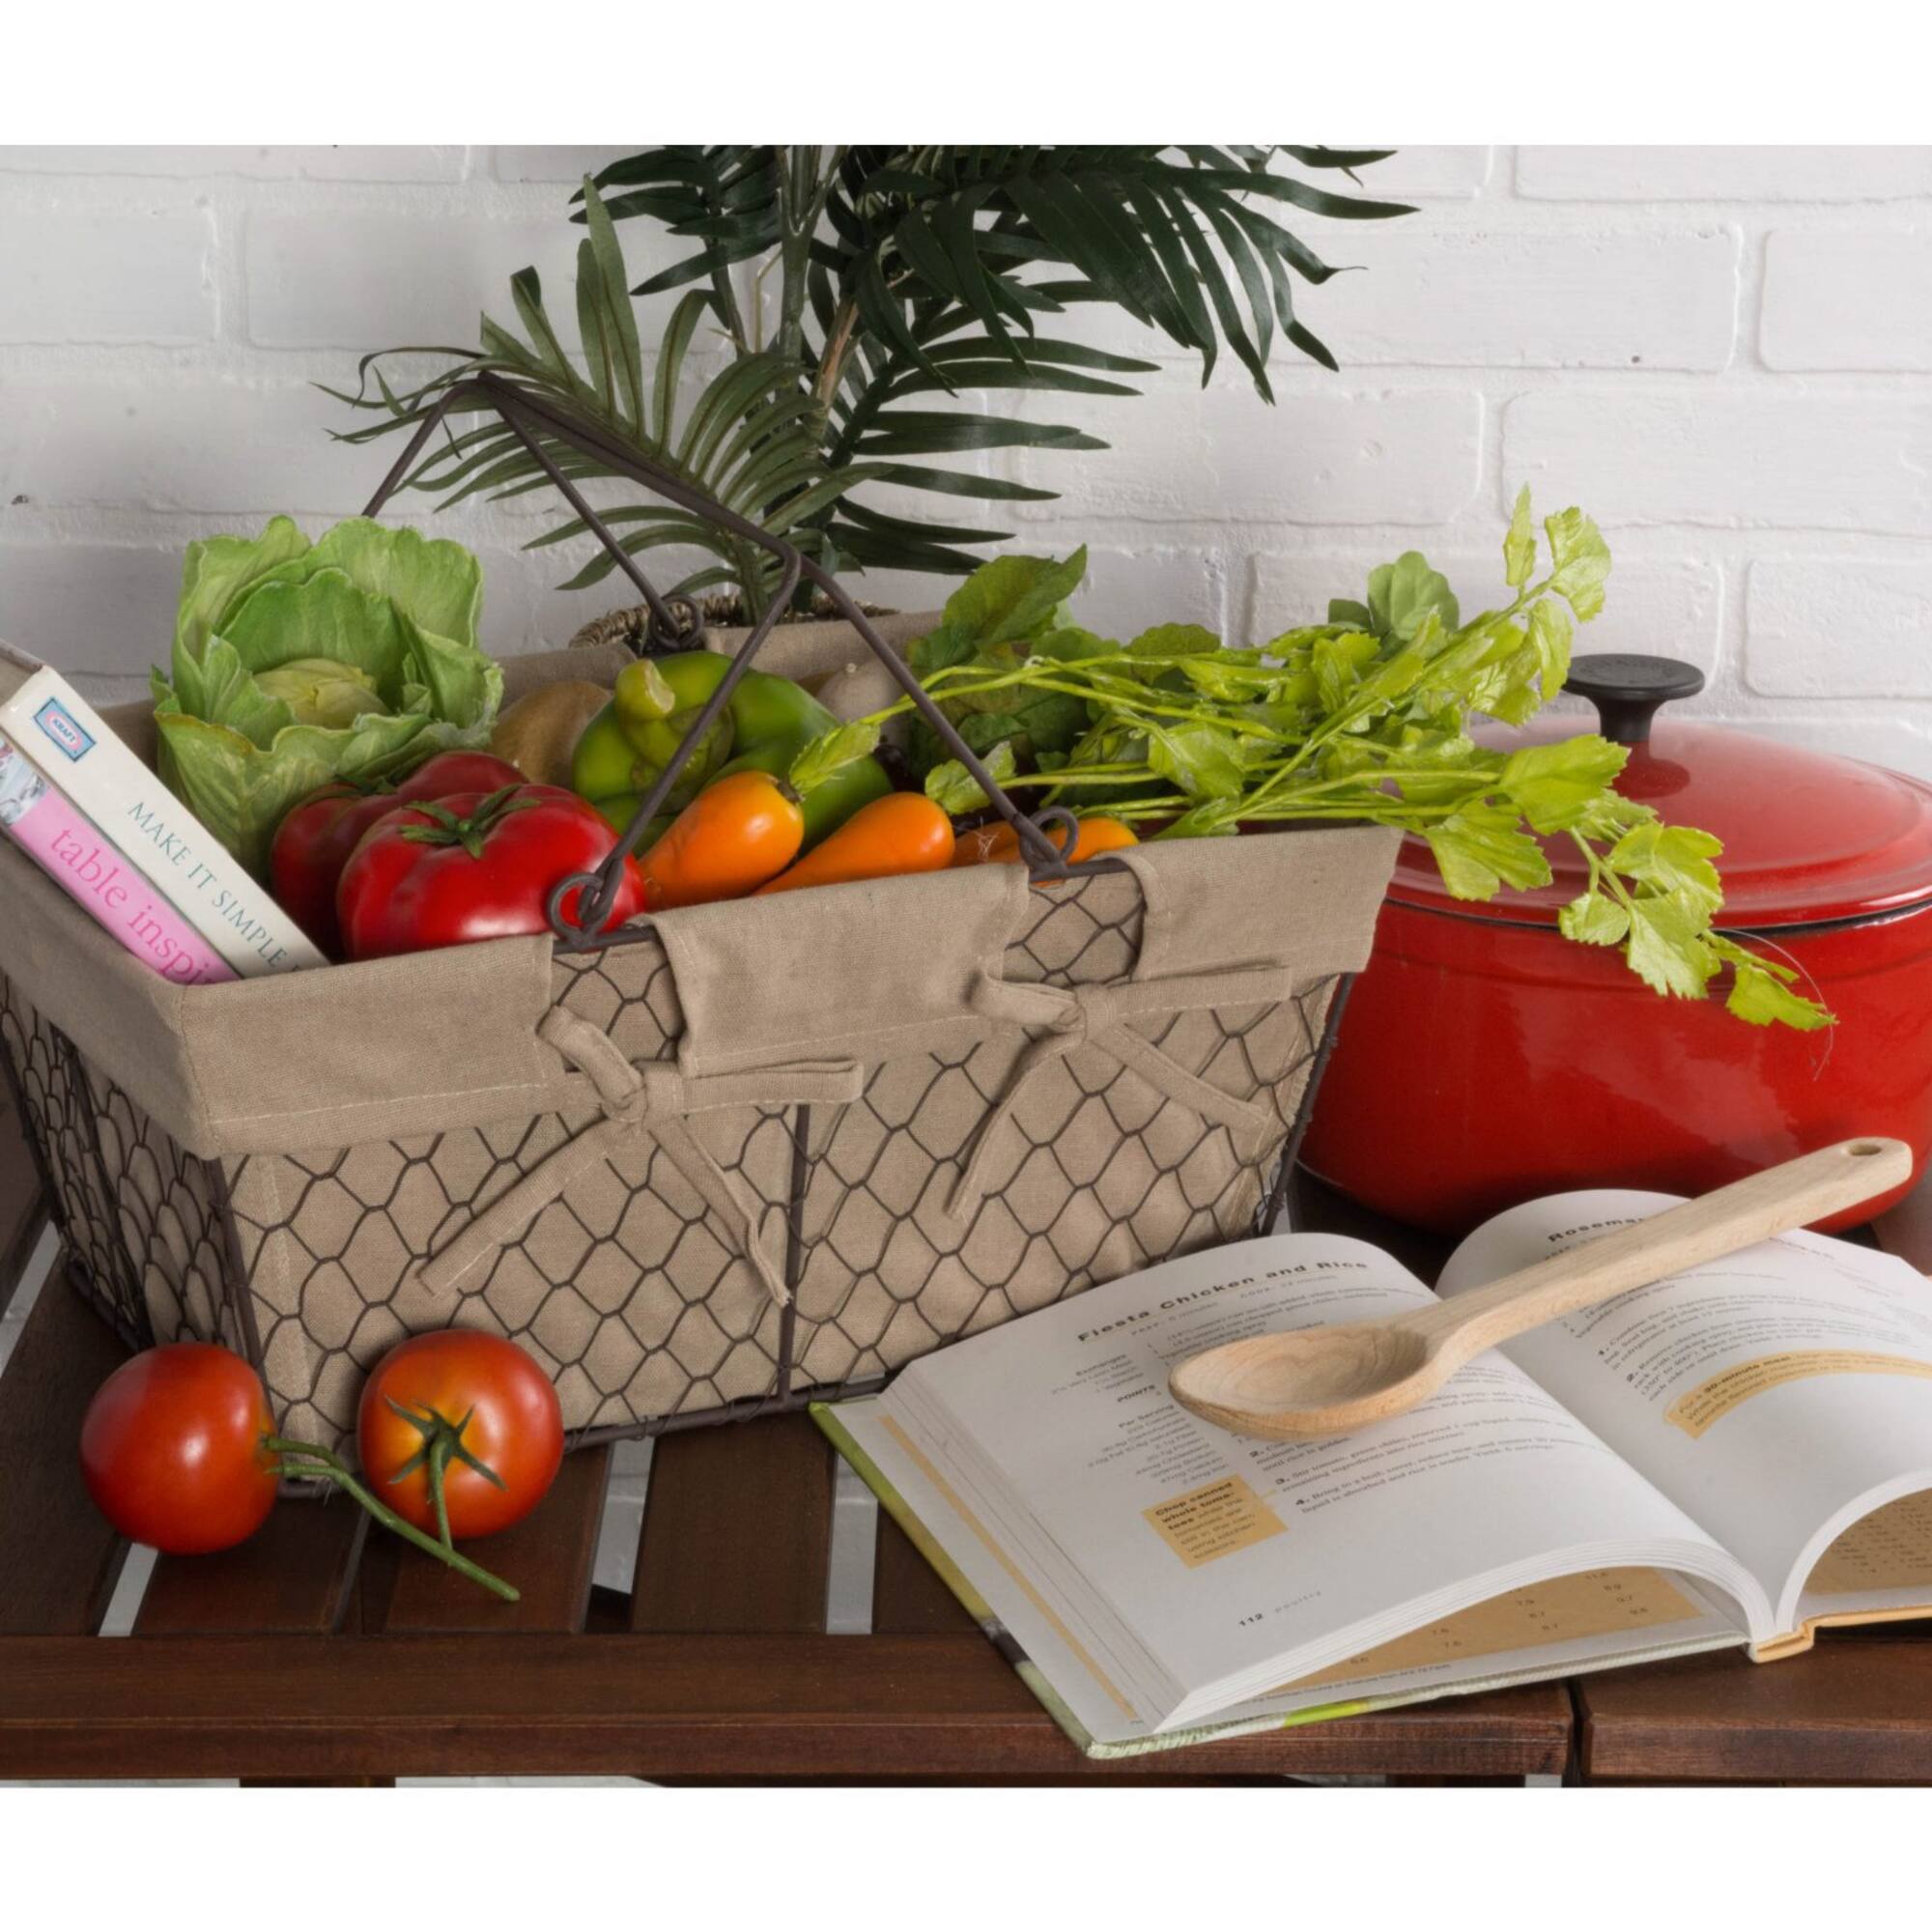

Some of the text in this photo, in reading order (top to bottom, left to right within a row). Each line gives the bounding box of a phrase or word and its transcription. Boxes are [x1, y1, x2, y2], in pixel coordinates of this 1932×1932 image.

[52, 718, 76, 743] KRAFT
[128, 802, 288, 967] MAKE IT SIMPLE
[51, 828, 214, 985] table inspi
[1077, 1310, 1150, 1342] Fiesta
[1160, 1275, 1255, 1310] Chicken
[1265, 1264, 1307, 1279] and
[1317, 1261, 1368, 1269] Rice
[1155, 1481, 1233, 1517] Chop canned
[1161, 1506, 1197, 1523] whole
[1238, 1612, 1264, 1627] 112
